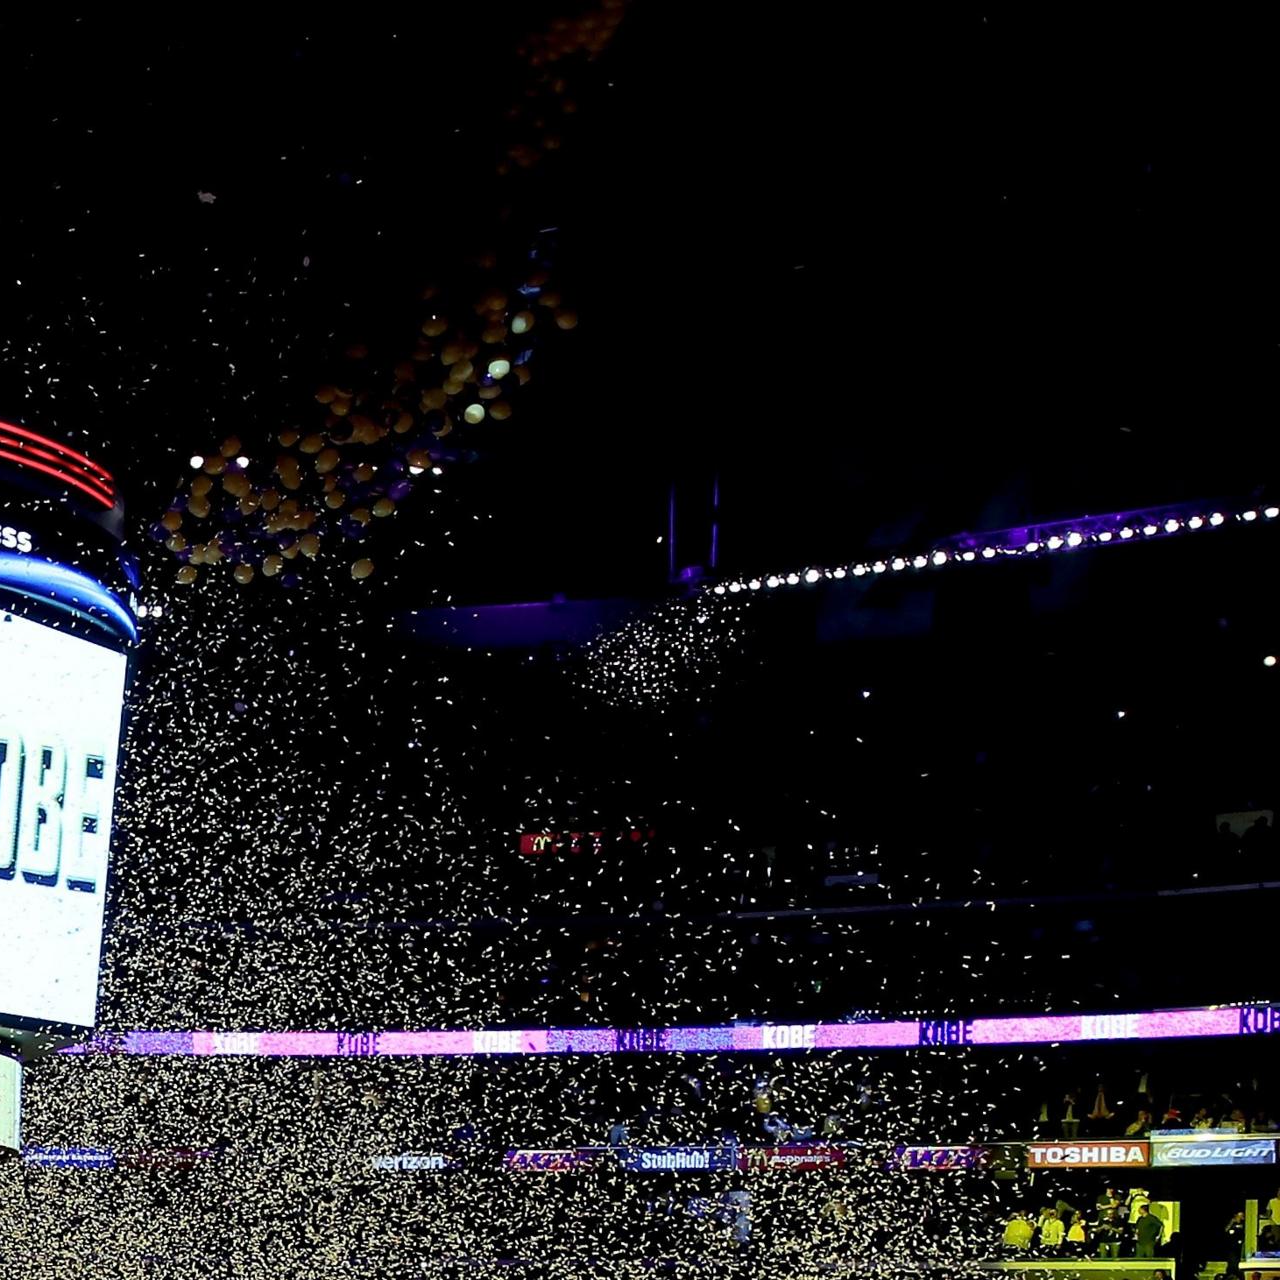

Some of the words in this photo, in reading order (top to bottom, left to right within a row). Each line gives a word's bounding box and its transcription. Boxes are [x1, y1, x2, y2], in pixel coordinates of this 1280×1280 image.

[762, 1025, 816, 1049] KOBE
[920, 1021, 974, 1046] KOBE
[1081, 1014, 1140, 1040] KOBE
[214, 1032, 260, 1055] KOBE
[473, 1030, 522, 1053] KOBE
[371, 1154, 444, 1170] verizon
[640, 1151, 710, 1169] StubHub!
[1030, 1145, 1145, 1164] TOSHIBA
[1166, 1147, 1213, 1159] BUD
[1212, 1146, 1272, 1159] LIGHT
